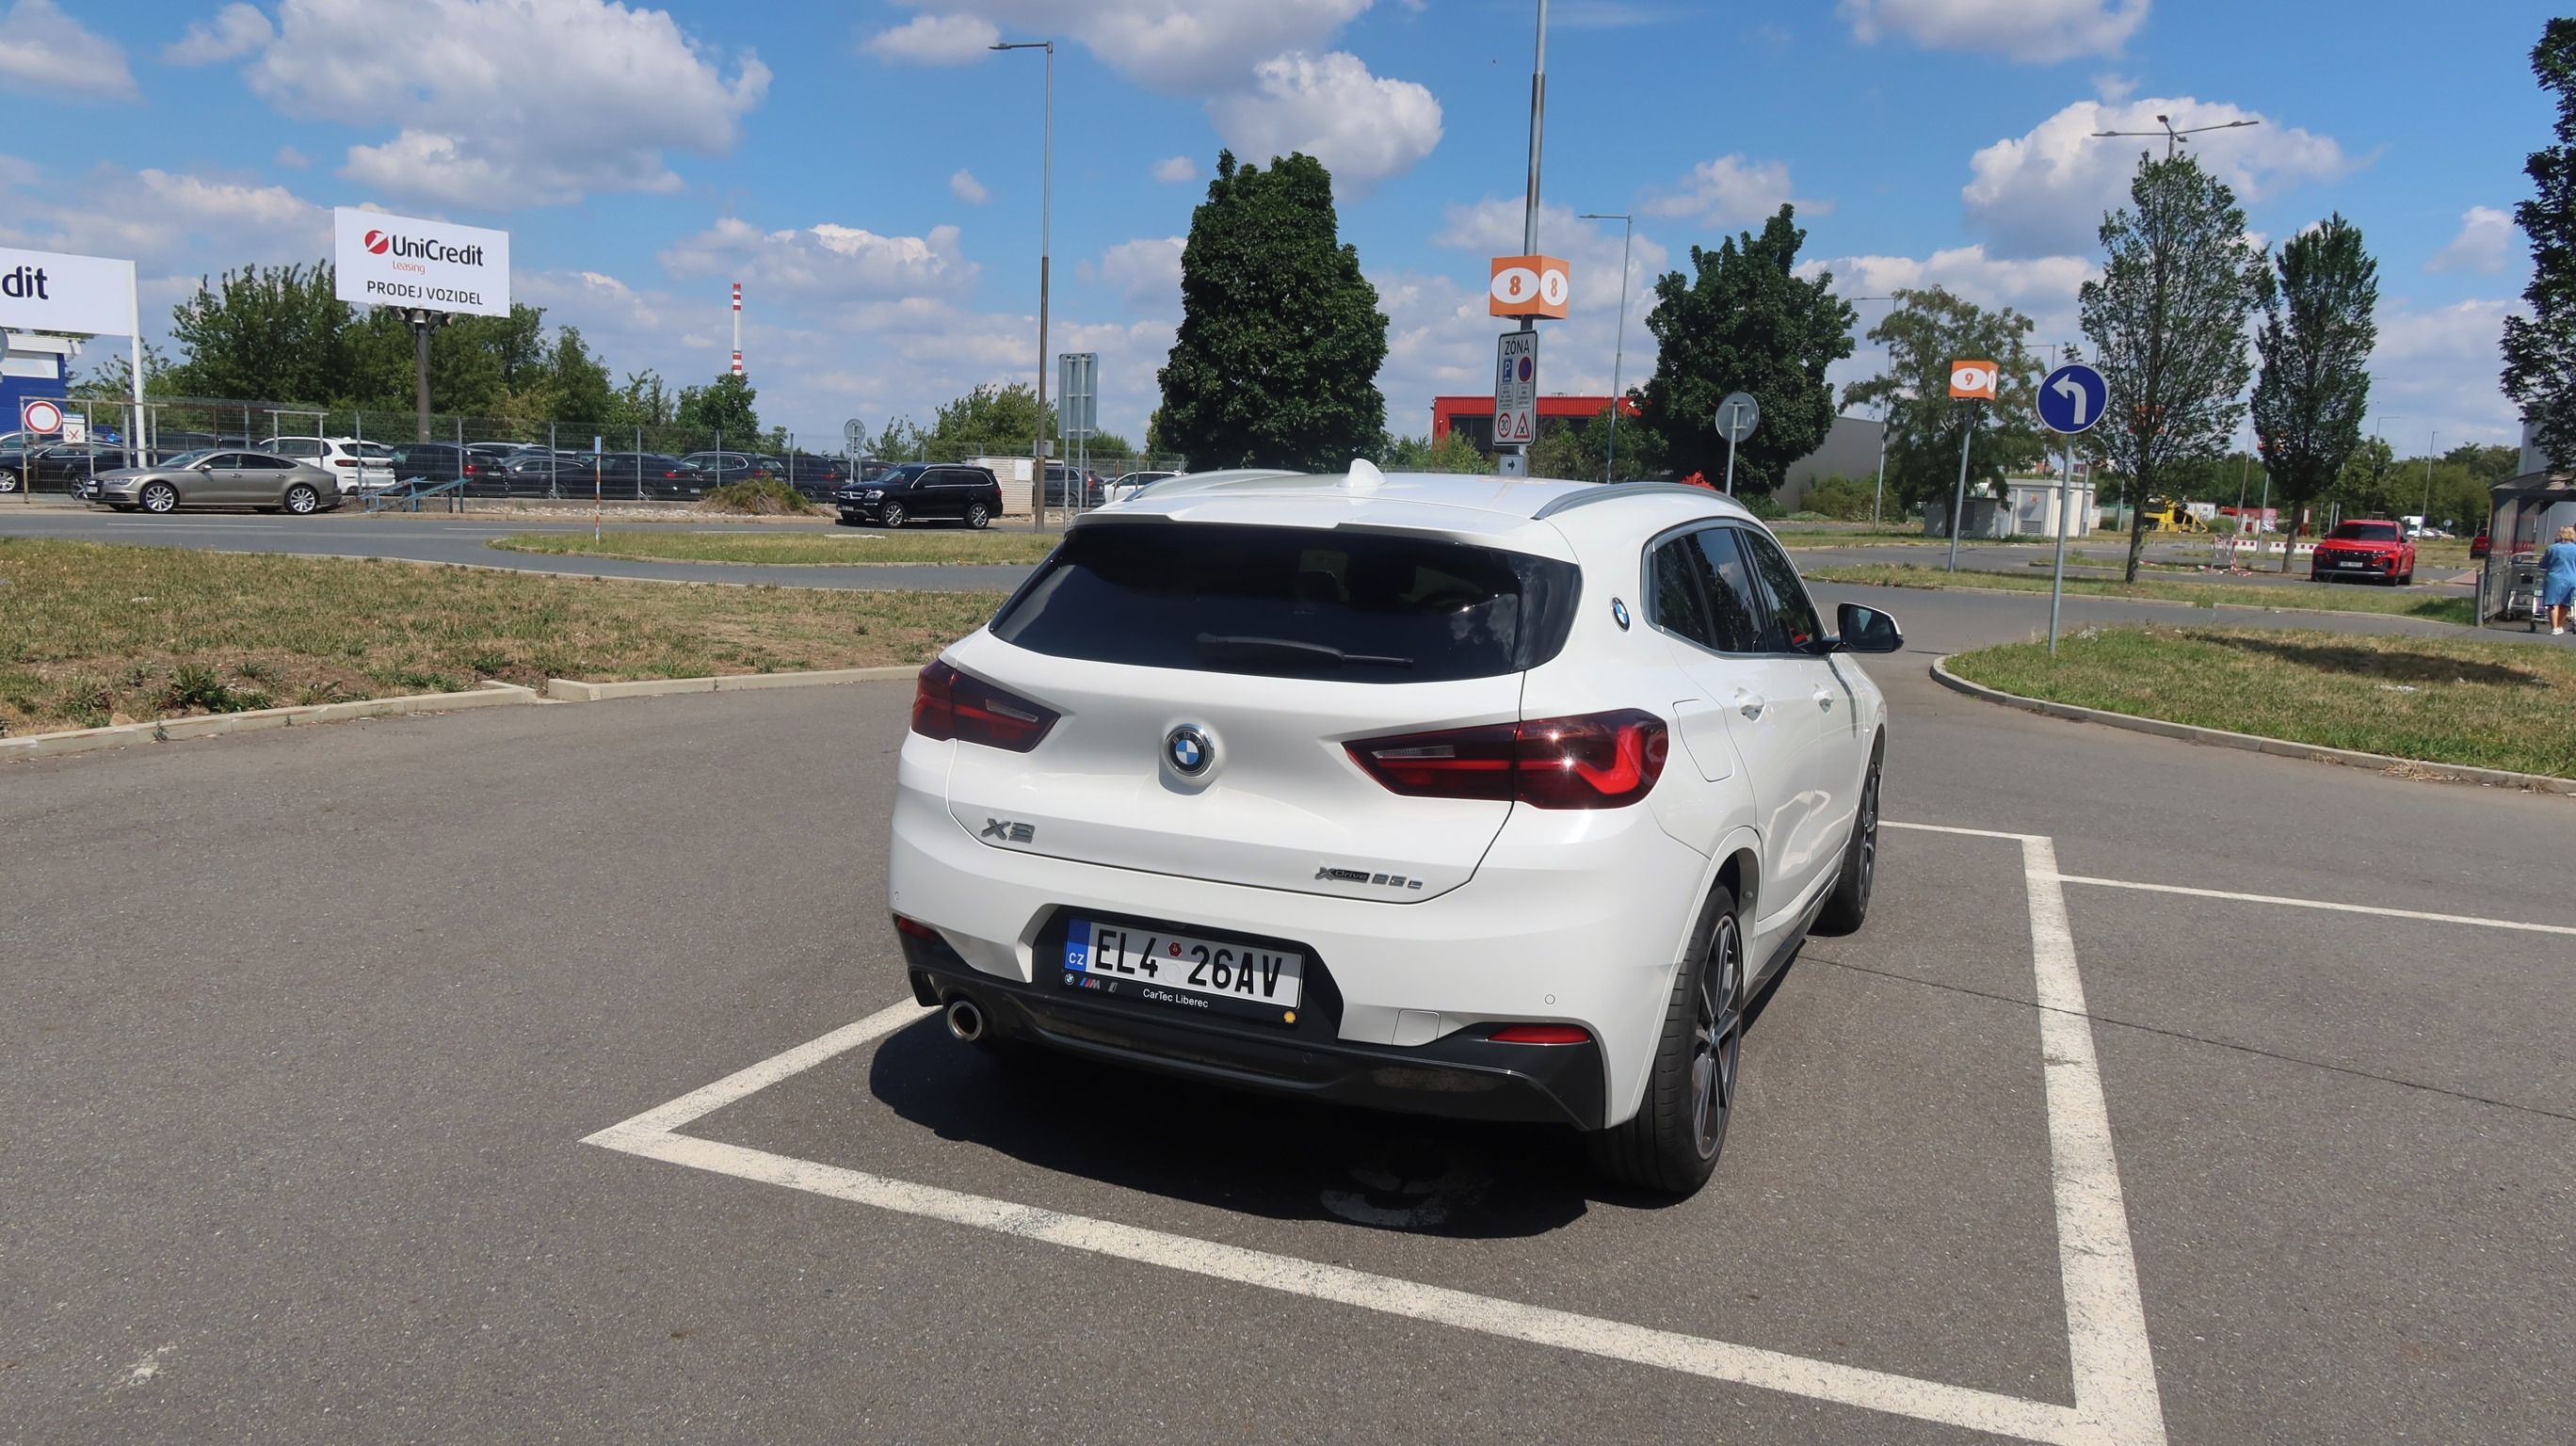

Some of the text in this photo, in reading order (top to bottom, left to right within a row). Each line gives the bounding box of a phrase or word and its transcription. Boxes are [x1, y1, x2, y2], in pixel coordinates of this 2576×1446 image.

[392, 234, 484, 266] UniCredit
[392, 260, 426, 275] Leasing
[366, 281, 483, 305] PRODEJ VOZIDEL
[1509, 275, 1521, 296] 8
[1965, 373, 1973, 386] 9
[1501, 420, 1509, 431] 30
[1069, 952, 1085, 966] CZ
[1094, 928, 1282, 998] EL4 26AV
[1142, 988, 1209, 1009] CarTec Liberec
